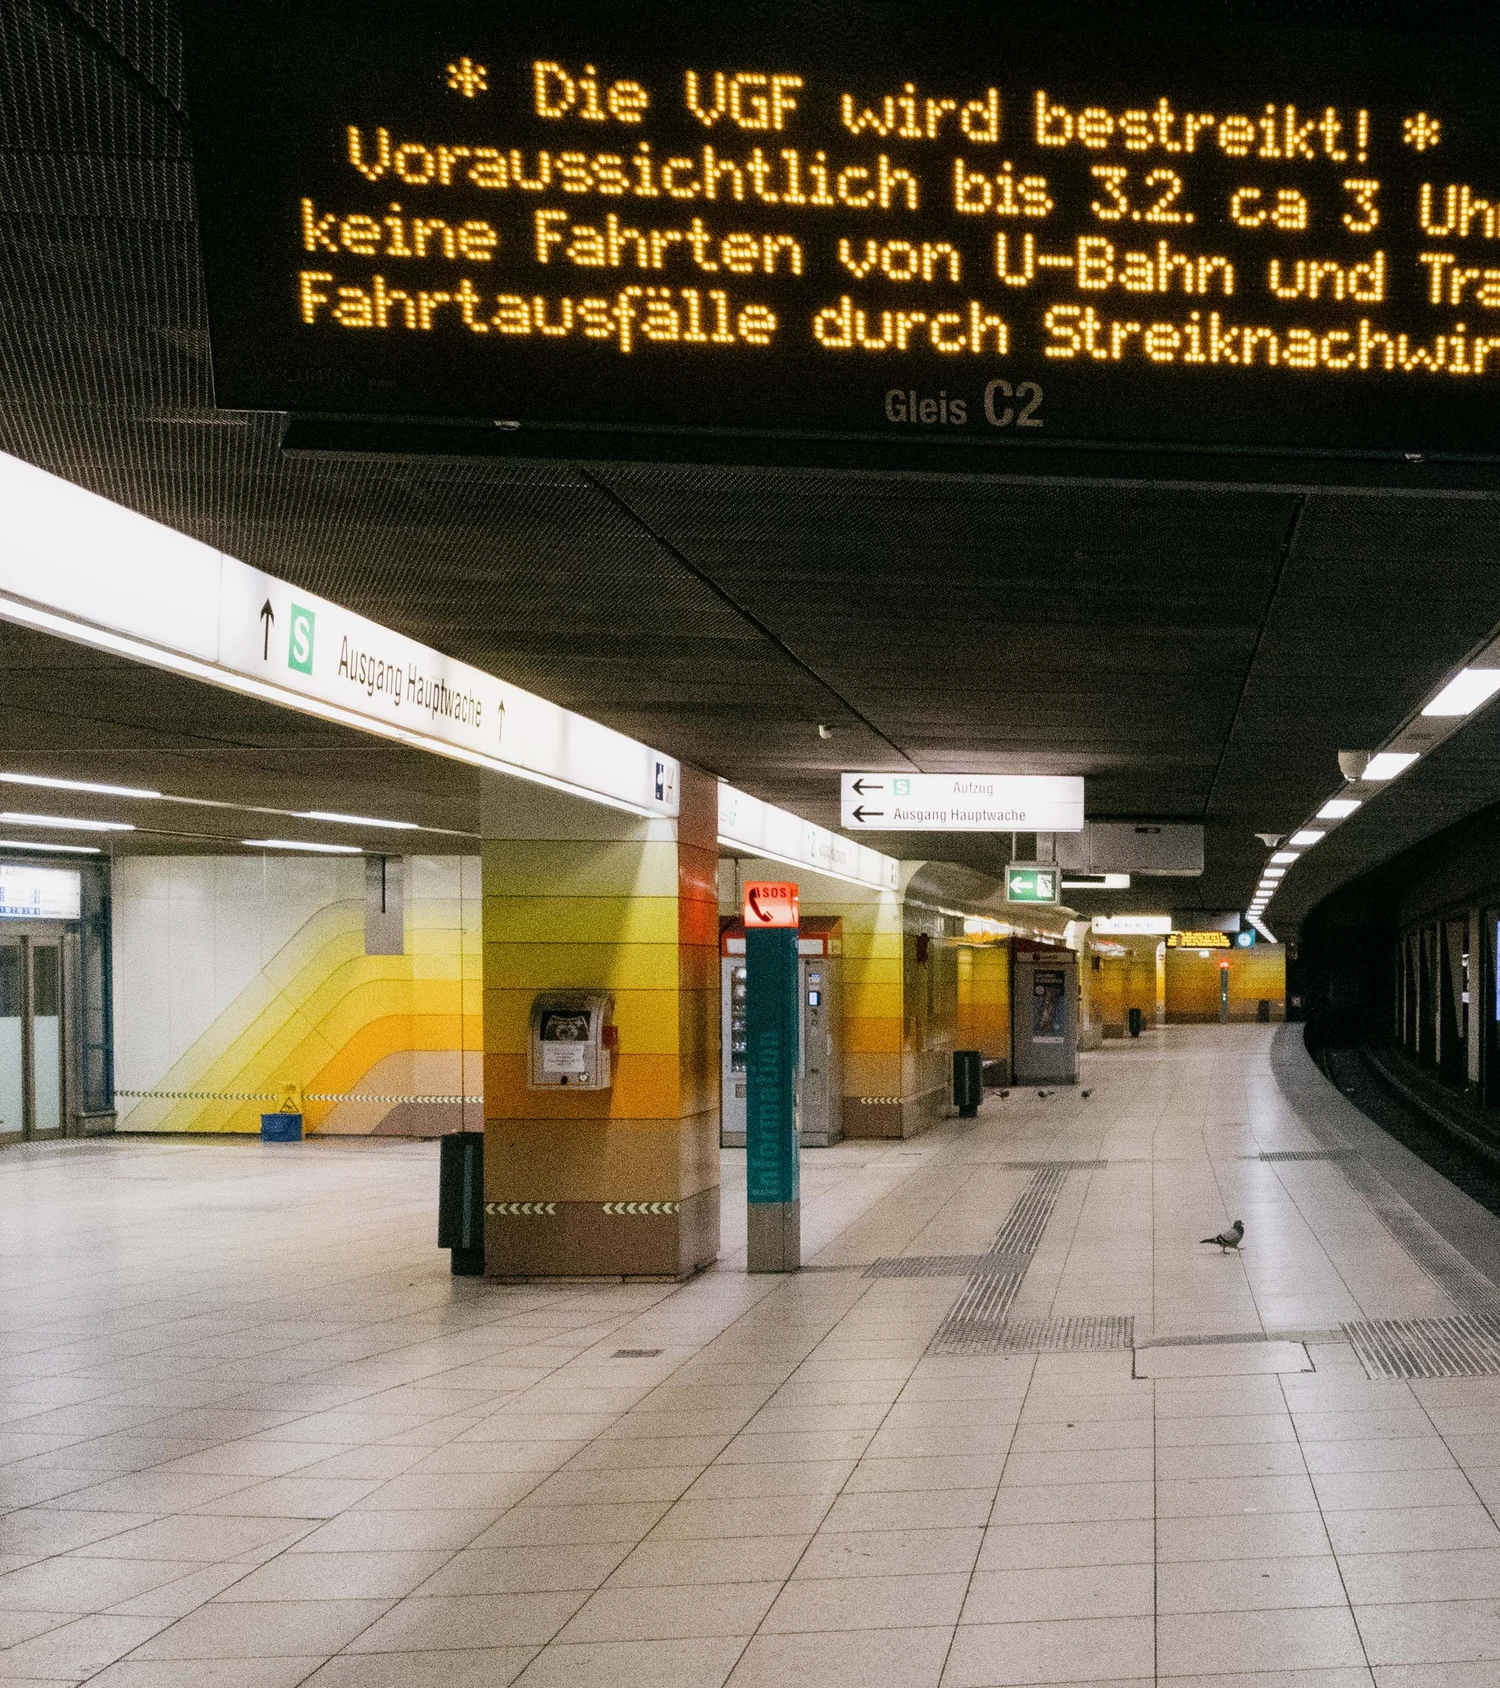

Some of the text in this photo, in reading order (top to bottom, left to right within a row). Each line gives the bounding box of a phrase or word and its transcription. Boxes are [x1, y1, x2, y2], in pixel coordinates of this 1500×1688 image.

[532, 60, 649, 122] Die
[685, 70, 804, 131] VGF
[841, 82, 999, 143] wird
[1035, 90, 1369, 163] bestreikt!
[348, 125, 919, 211] Voraussichtlich
[954, 158, 1054, 218] bis
[1090, 166, 1195, 224] 3.2.
[1230, 187, 1308, 230] ca
[1342, 179, 1380, 233] 3
[301, 198, 498, 262] keine
[534, 208, 803, 276] Fahrten
[838, 238, 961, 283] von
[995, 231, 1235, 296] U-Bahn
[1268, 251, 1386, 303] und
[299, 271, 778, 353] Fahrtausfälle
[813, 295, 1009, 355] durch
[884, 378, 1044, 427] Gleis C2
[292, 615, 483, 728] S Ausgang Hauptwache
[893, 808, 1026, 823] Ausgang Hauptwache
[895, 780, 994, 797] S Aufzug
[762, 887, 787, 898] SOS
